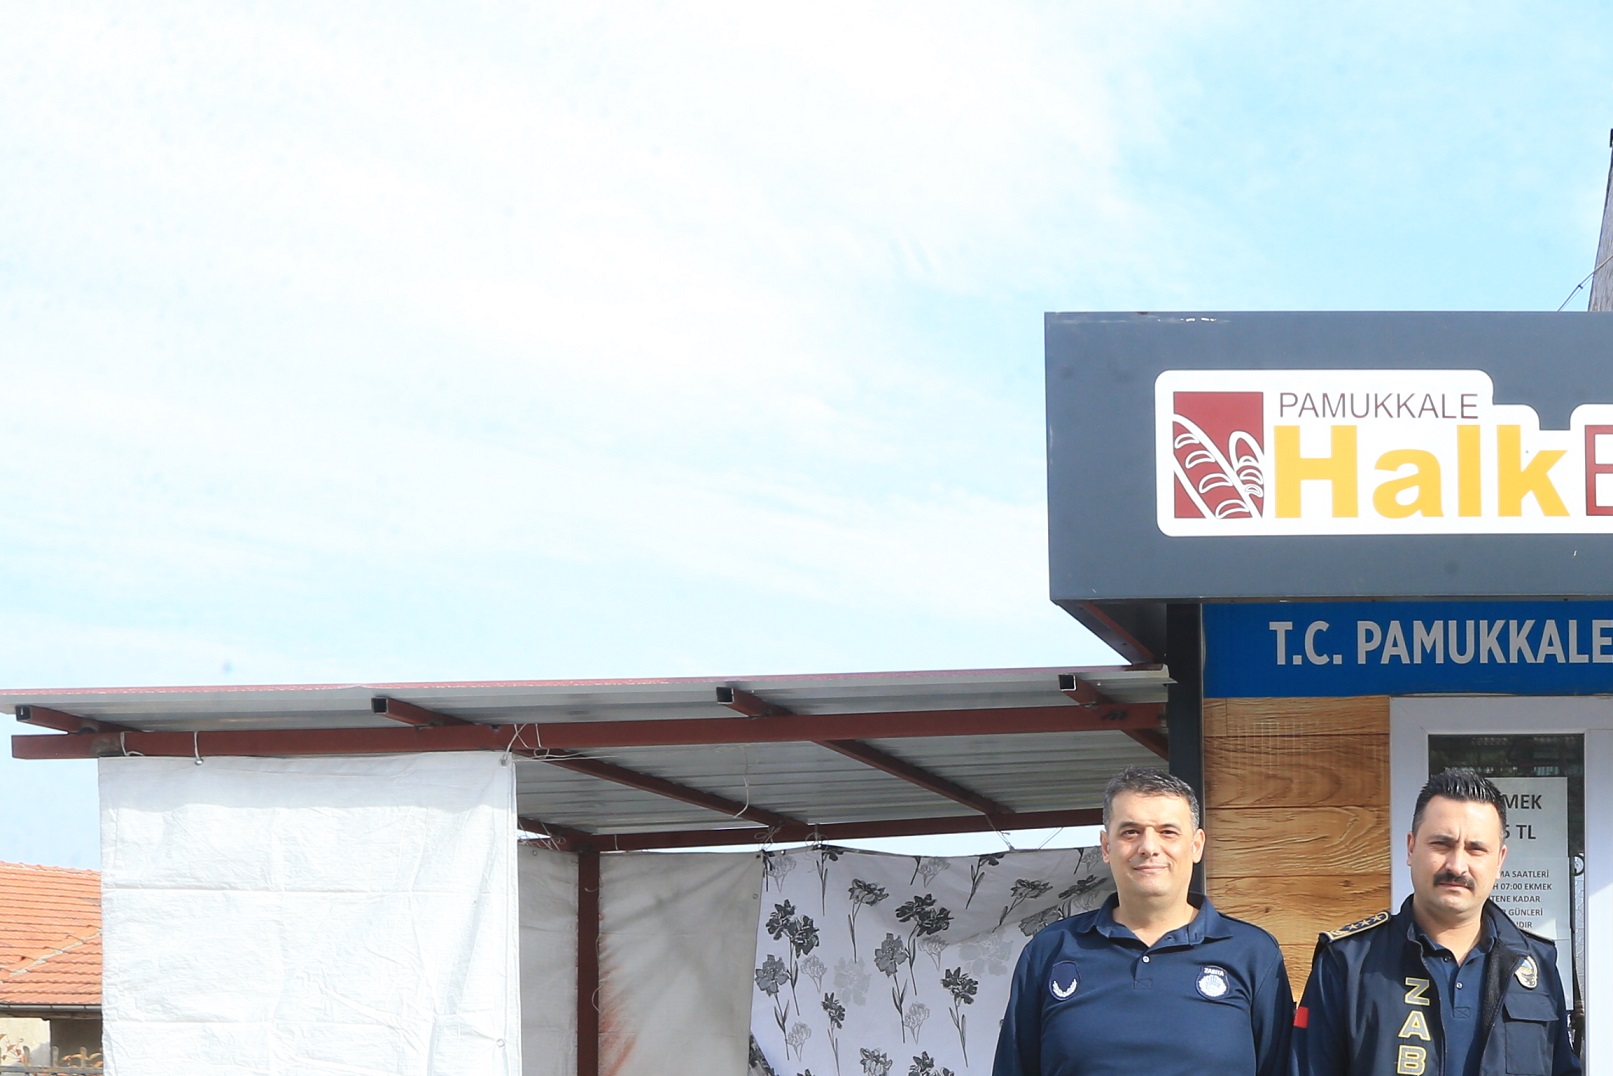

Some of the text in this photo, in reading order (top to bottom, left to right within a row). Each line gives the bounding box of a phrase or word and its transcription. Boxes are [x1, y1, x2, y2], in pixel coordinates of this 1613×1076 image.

[1279, 391, 1479, 419] PAMUKKALE
[1269, 620, 1342, 665] T.C.
[1357, 619, 1613, 665] PAMUKKALE
[1501, 794, 1542, 809] MEK
[1516, 825, 1536, 840] TL
[1512, 870, 1549, 878] SAATLERİ
[1500, 883, 1523, 891] 07:00
[1491, 895, 1511, 903] TENE
[1508, 907, 1543, 916] GÜNLERİ
